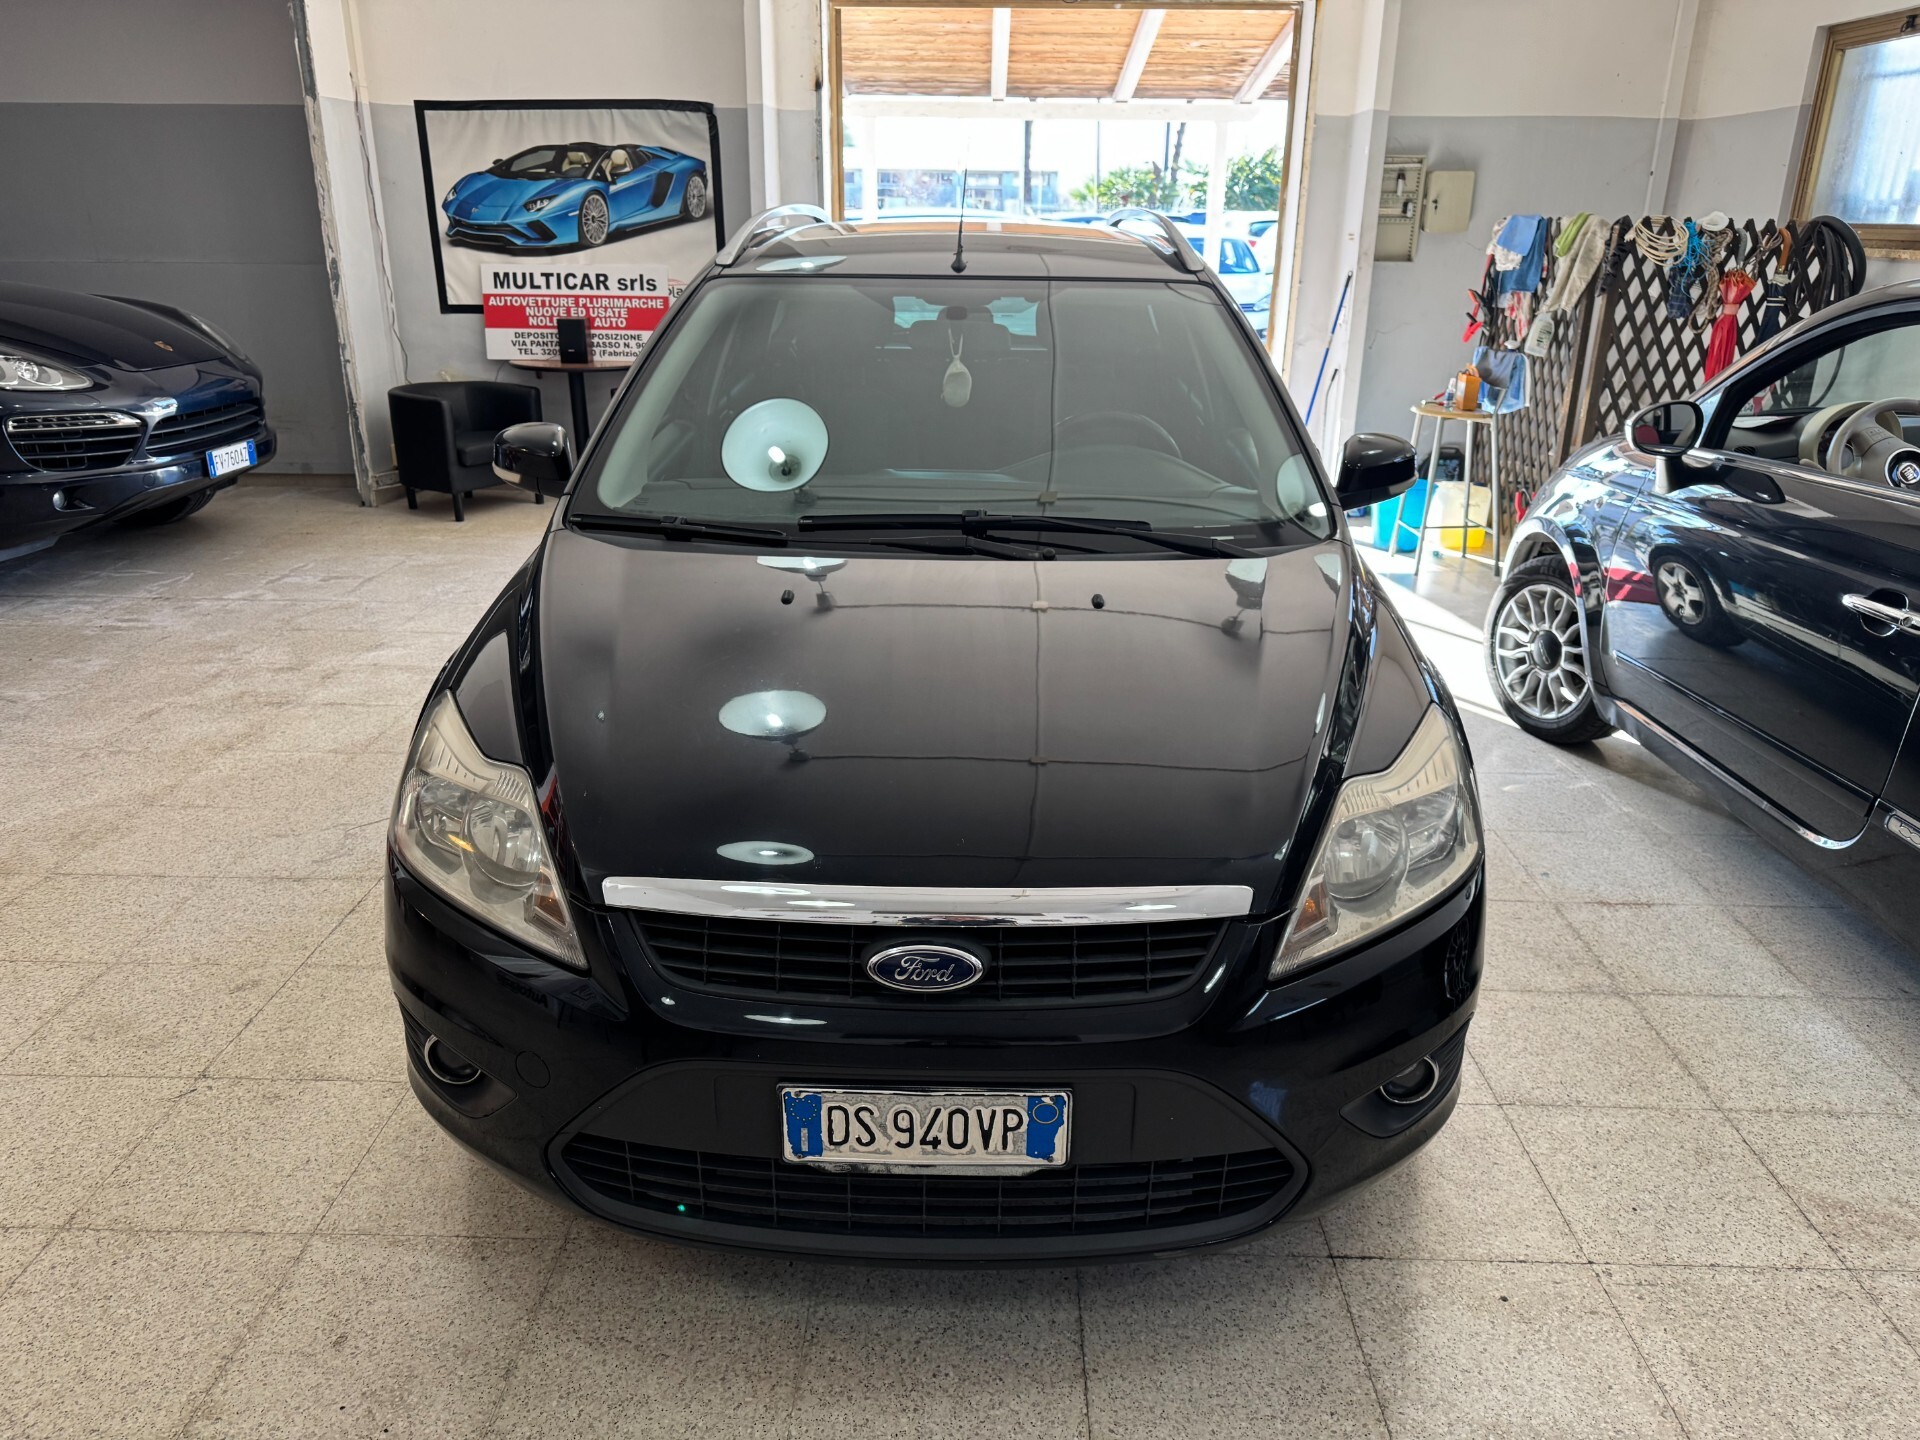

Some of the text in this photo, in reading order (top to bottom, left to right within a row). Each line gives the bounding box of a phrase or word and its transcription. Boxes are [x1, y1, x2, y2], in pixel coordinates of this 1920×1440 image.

[493, 272, 657, 292] MULTICAR srls
[488, 296, 664, 309] AUTOVETTURE PLURIMARCHE
[525, 307, 628, 318] NUOVE ED USATE
[594, 318, 627, 328] AUTO
[591, 333, 643, 341] POSIZIONE
[530, 340, 560, 348] PANTA
[518, 347, 539, 356] TEL.
[894, 955, 956, 982] Ford
[827, 1104, 877, 1148] DS
[893, 1106, 1024, 1151] 940VP
